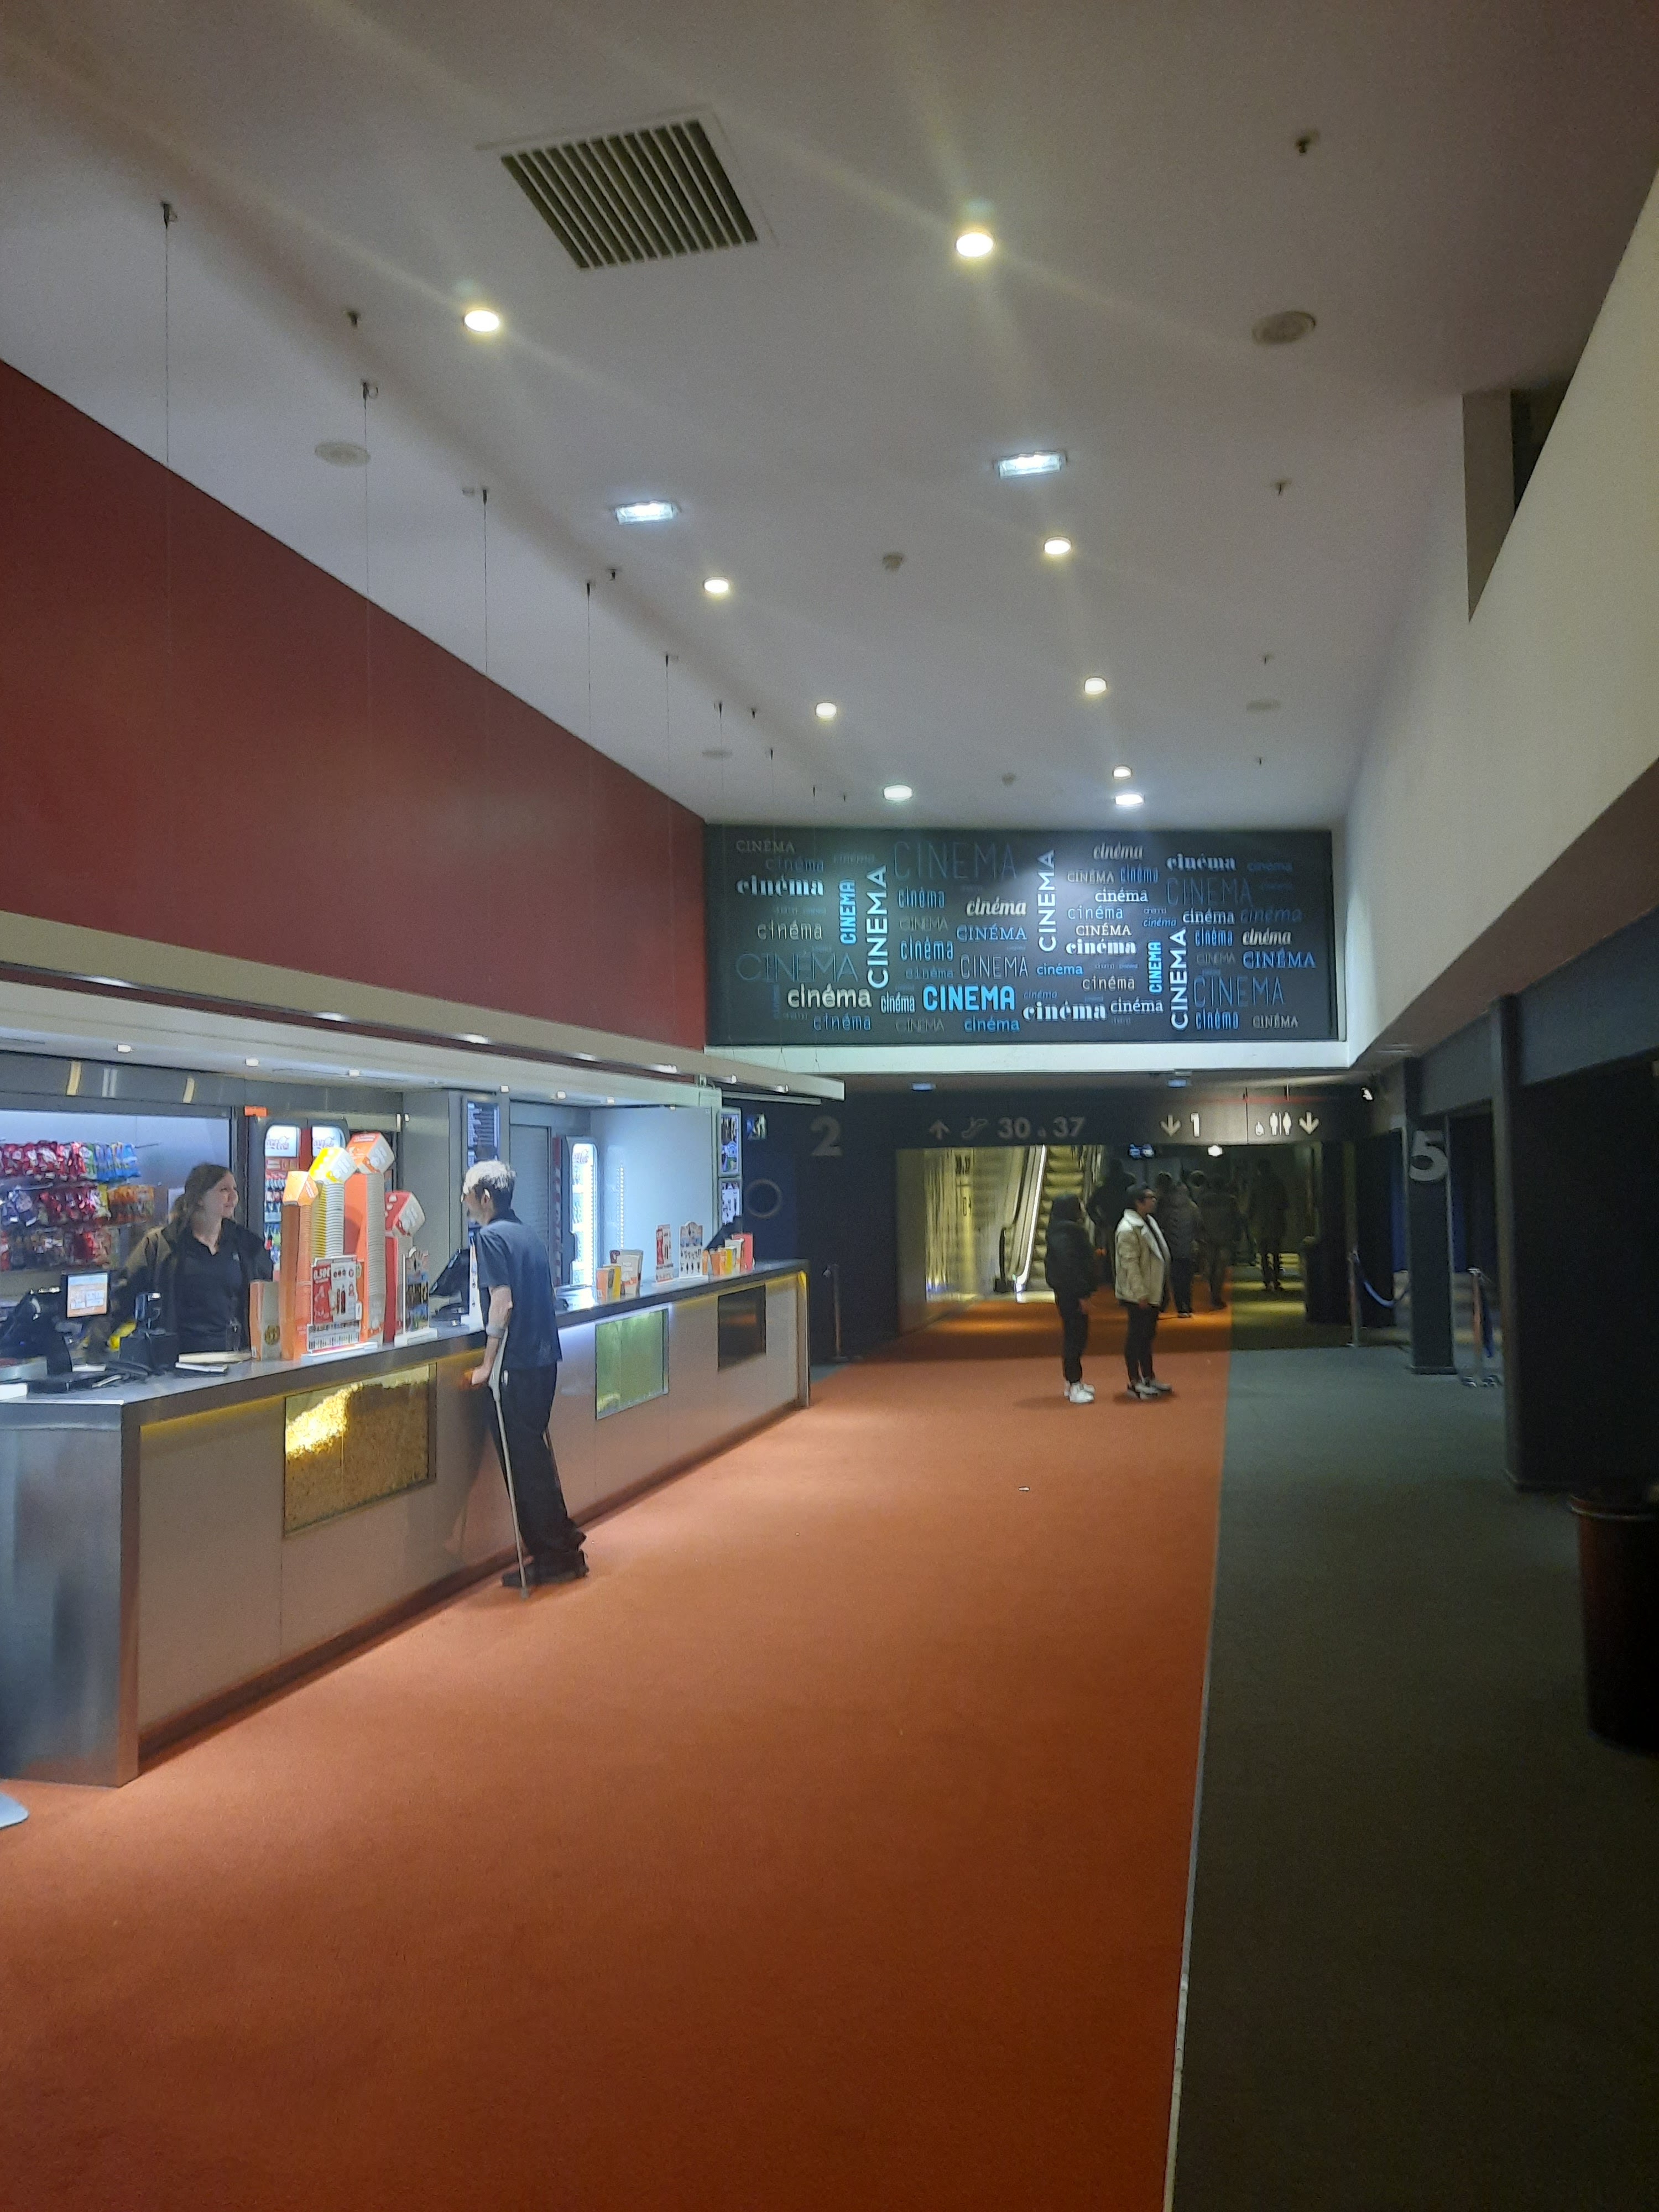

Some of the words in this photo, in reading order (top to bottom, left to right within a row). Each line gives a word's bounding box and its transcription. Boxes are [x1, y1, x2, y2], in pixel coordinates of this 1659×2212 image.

[894, 841, 1017, 880] CINEMA
[1093, 842, 1143, 860] cinéma
[1166, 853, 1237, 870] cinéma
[1120, 864, 1159, 883] cinéma
[735, 874, 824, 896] cinéma
[1095, 887, 1149, 902] cinéma
[1167, 878, 1253, 906] CINEMA
[898, 886, 945, 908] cinéma
[966, 896, 1027, 917] cinéma
[1037, 849, 1057, 952] CINEMA
[838, 878, 857, 945] CINEMA
[1067, 905, 1124, 920] cinéma
[1143, 916, 1177, 927] cinéma
[1182, 907, 1235, 925] cinéma
[757, 919, 822, 941] cinéma
[866, 864, 889, 989] CINEMA
[956, 923, 1027, 942] CINÉMA
[1076, 923, 1132, 936] CINÉMA
[1195, 927, 1233, 946] cinéma
[1243, 927, 1291, 946] cinéma
[900, 935, 954, 961] cinéma
[1066, 938, 1136, 956] cinéma
[1242, 947, 1316, 969] CINÉMA
[906, 966, 954, 979] cinéma
[961, 954, 1029, 979] CINEMA
[1036, 963, 1083, 977] cinéma
[1147, 940, 1162, 995] CINEMA
[1082, 974, 1135, 992] cinéma
[1169, 926, 1190, 1031] CINEMA
[787, 983, 873, 1008] cinéma
[880, 991, 915, 1013] cinéma
[923, 984, 1015, 1012] CINEMA
[1194, 975, 1285, 1007] CINEMA
[1023, 1000, 1107, 1021] cinéma
[1110, 996, 1164, 1014] cinéma
[813, 1013, 872, 1031] cinéma
[964, 1015, 1020, 1032] cinéma
[1195, 1008, 1239, 1030] cinéma
[810, 1115, 843, 1156] 2
[997, 1117, 1031, 1139] 30
[1052, 1116, 1084, 1138] 37
[1190, 1113, 1201, 1138] 1
[1409, 1130, 1448, 1181] 5
